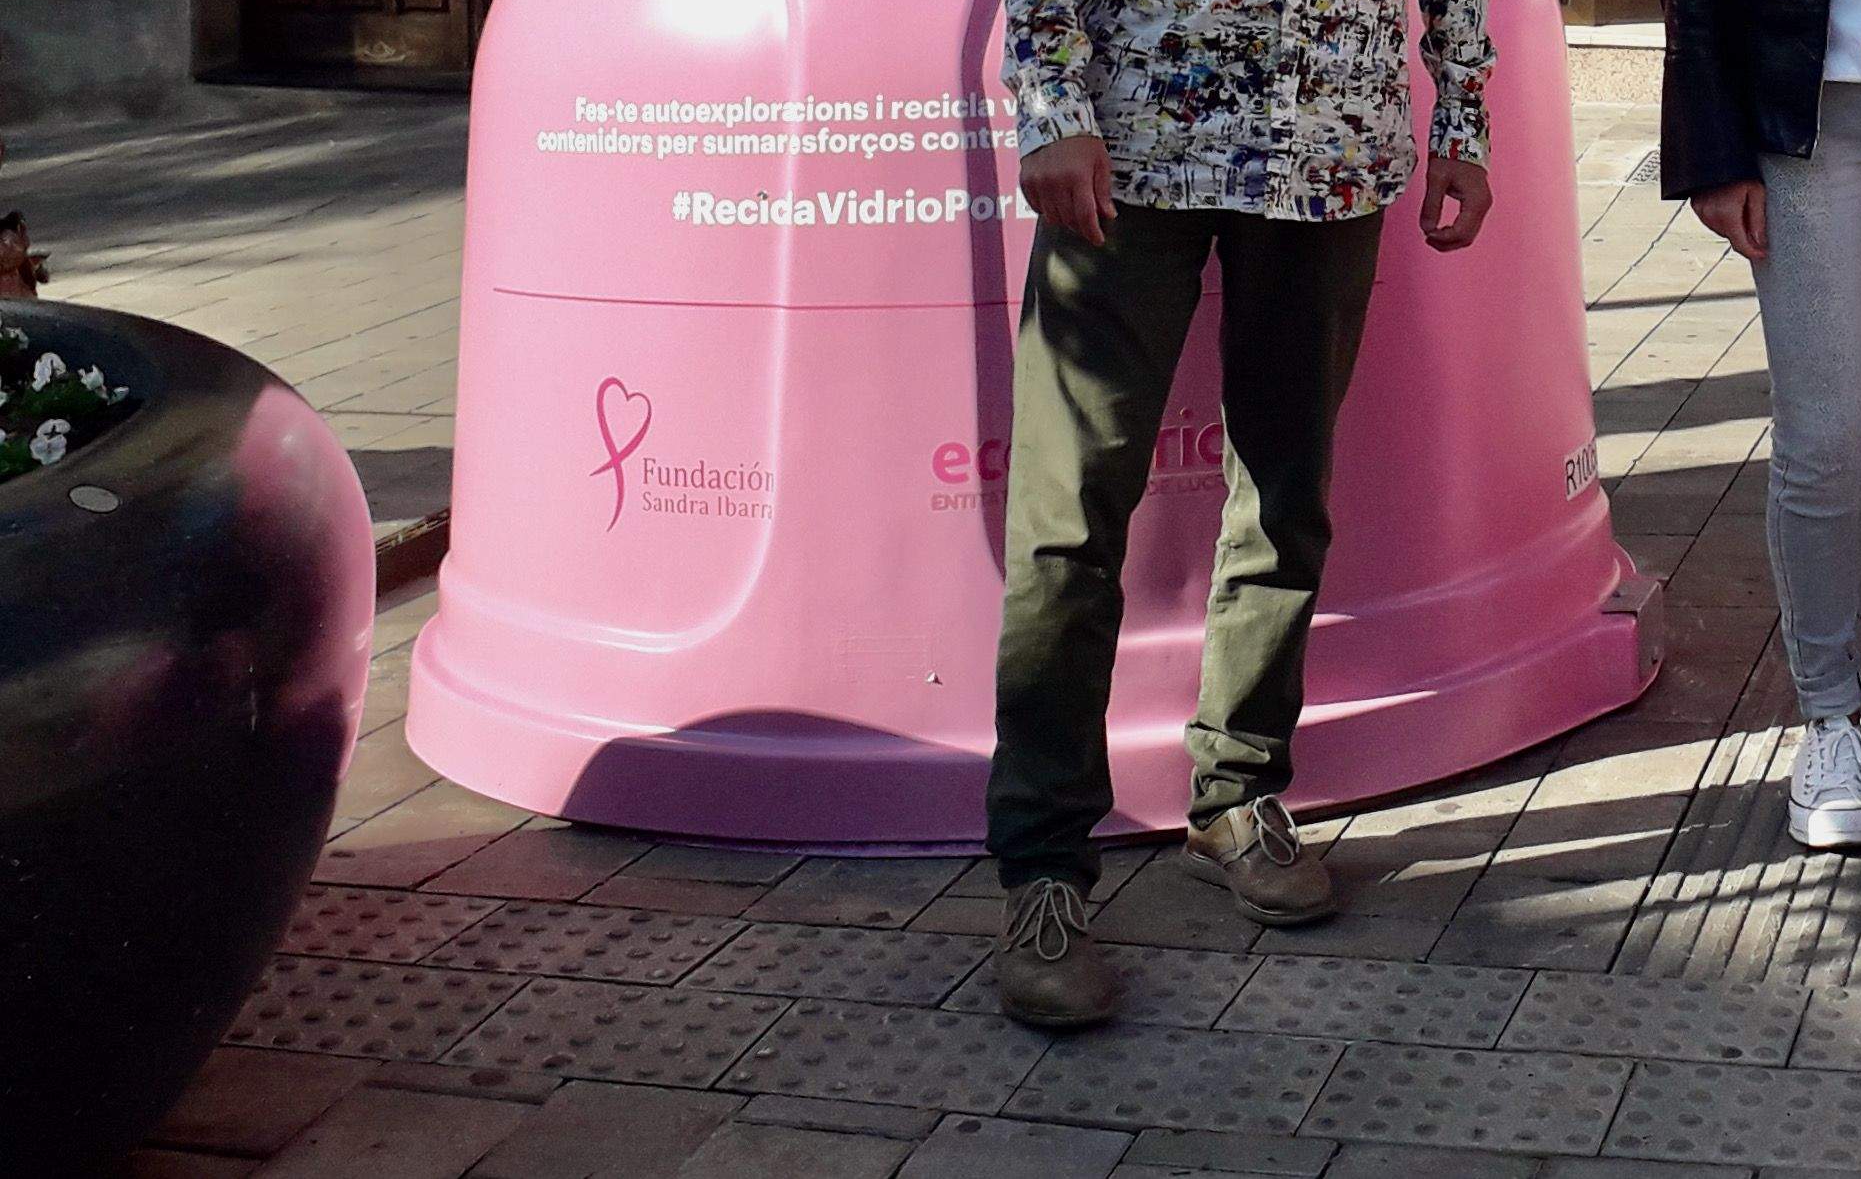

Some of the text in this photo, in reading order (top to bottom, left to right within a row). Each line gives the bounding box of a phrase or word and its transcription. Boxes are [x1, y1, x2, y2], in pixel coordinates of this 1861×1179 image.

[575, 96, 638, 122] Fes-te
[642, 94, 869, 128] autoexploracions
[875, 94, 884, 120] i
[891, 92, 995, 121] recicla
[536, 127, 1018, 160] contenidors per sumar esforços contra
[642, 457, 775, 493] Fundación
[642, 491, 773, 520] Sandra Ibarra
